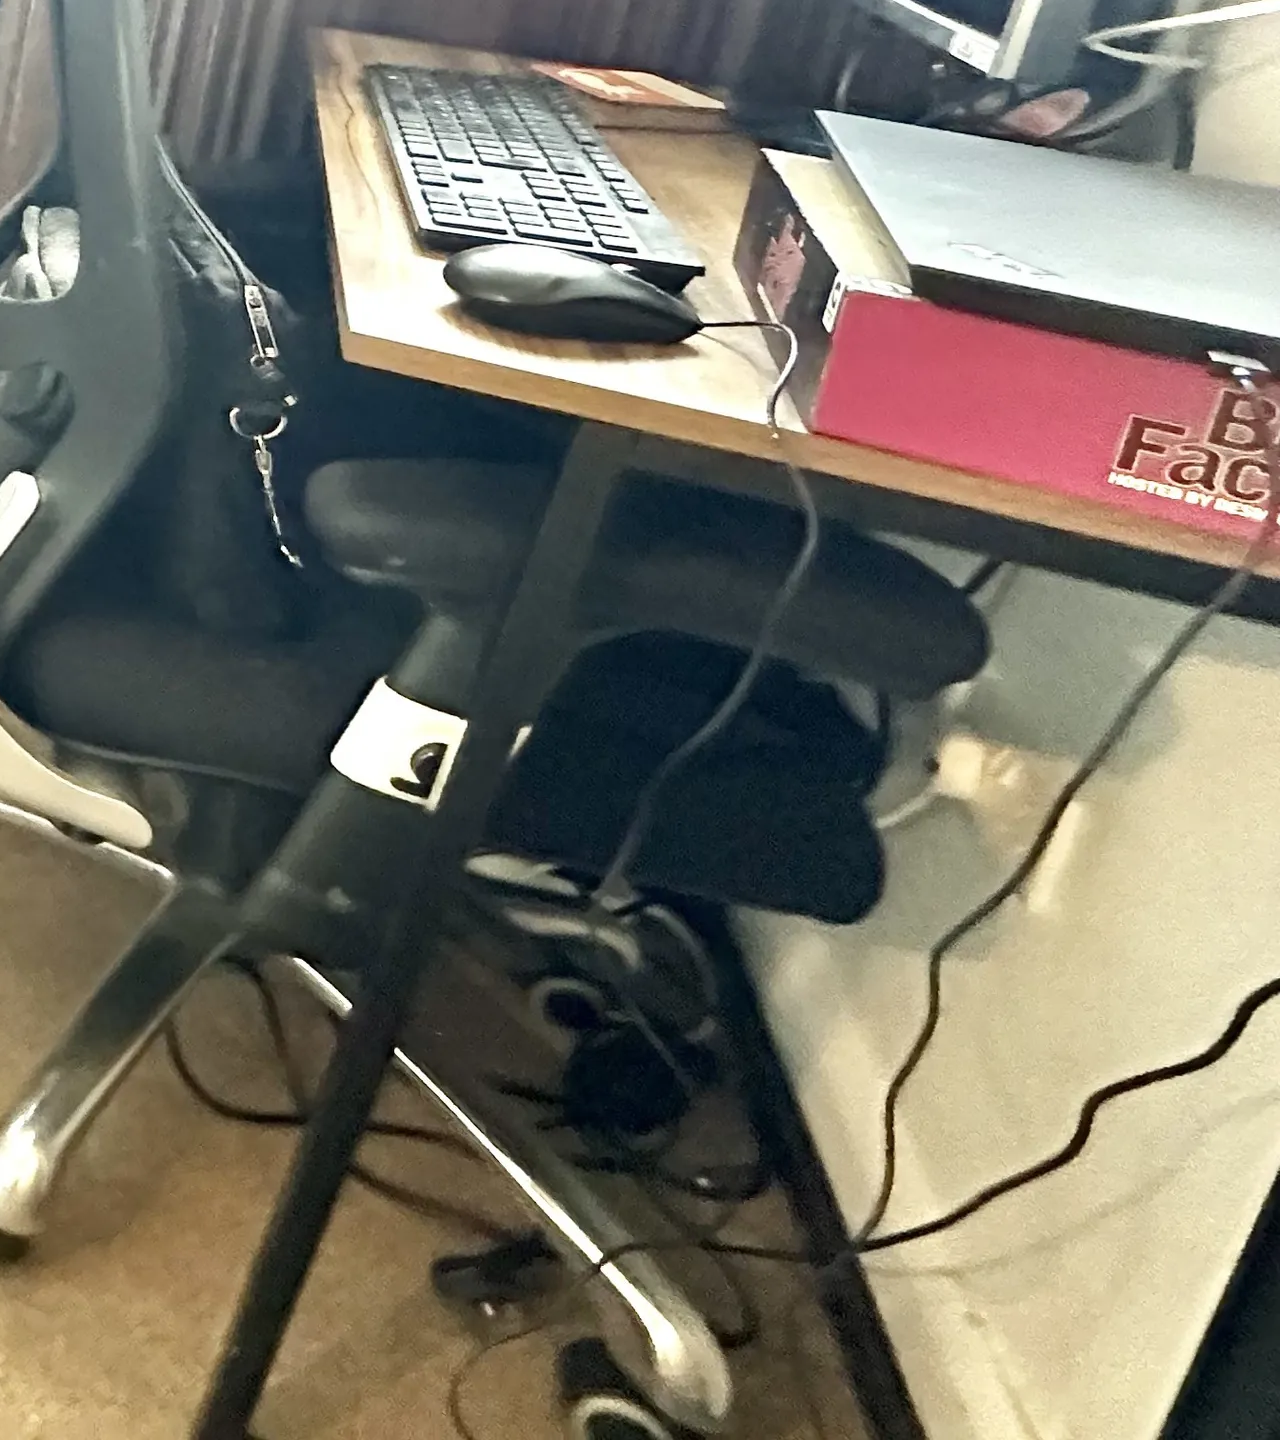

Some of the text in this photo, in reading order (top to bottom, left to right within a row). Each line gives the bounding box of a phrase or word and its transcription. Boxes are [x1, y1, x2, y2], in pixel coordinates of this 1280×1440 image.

[1108, 471, 1184, 501] HOSTED
[1184, 490, 1215, 509] BY
[1115, 415, 1272, 504] Fac
